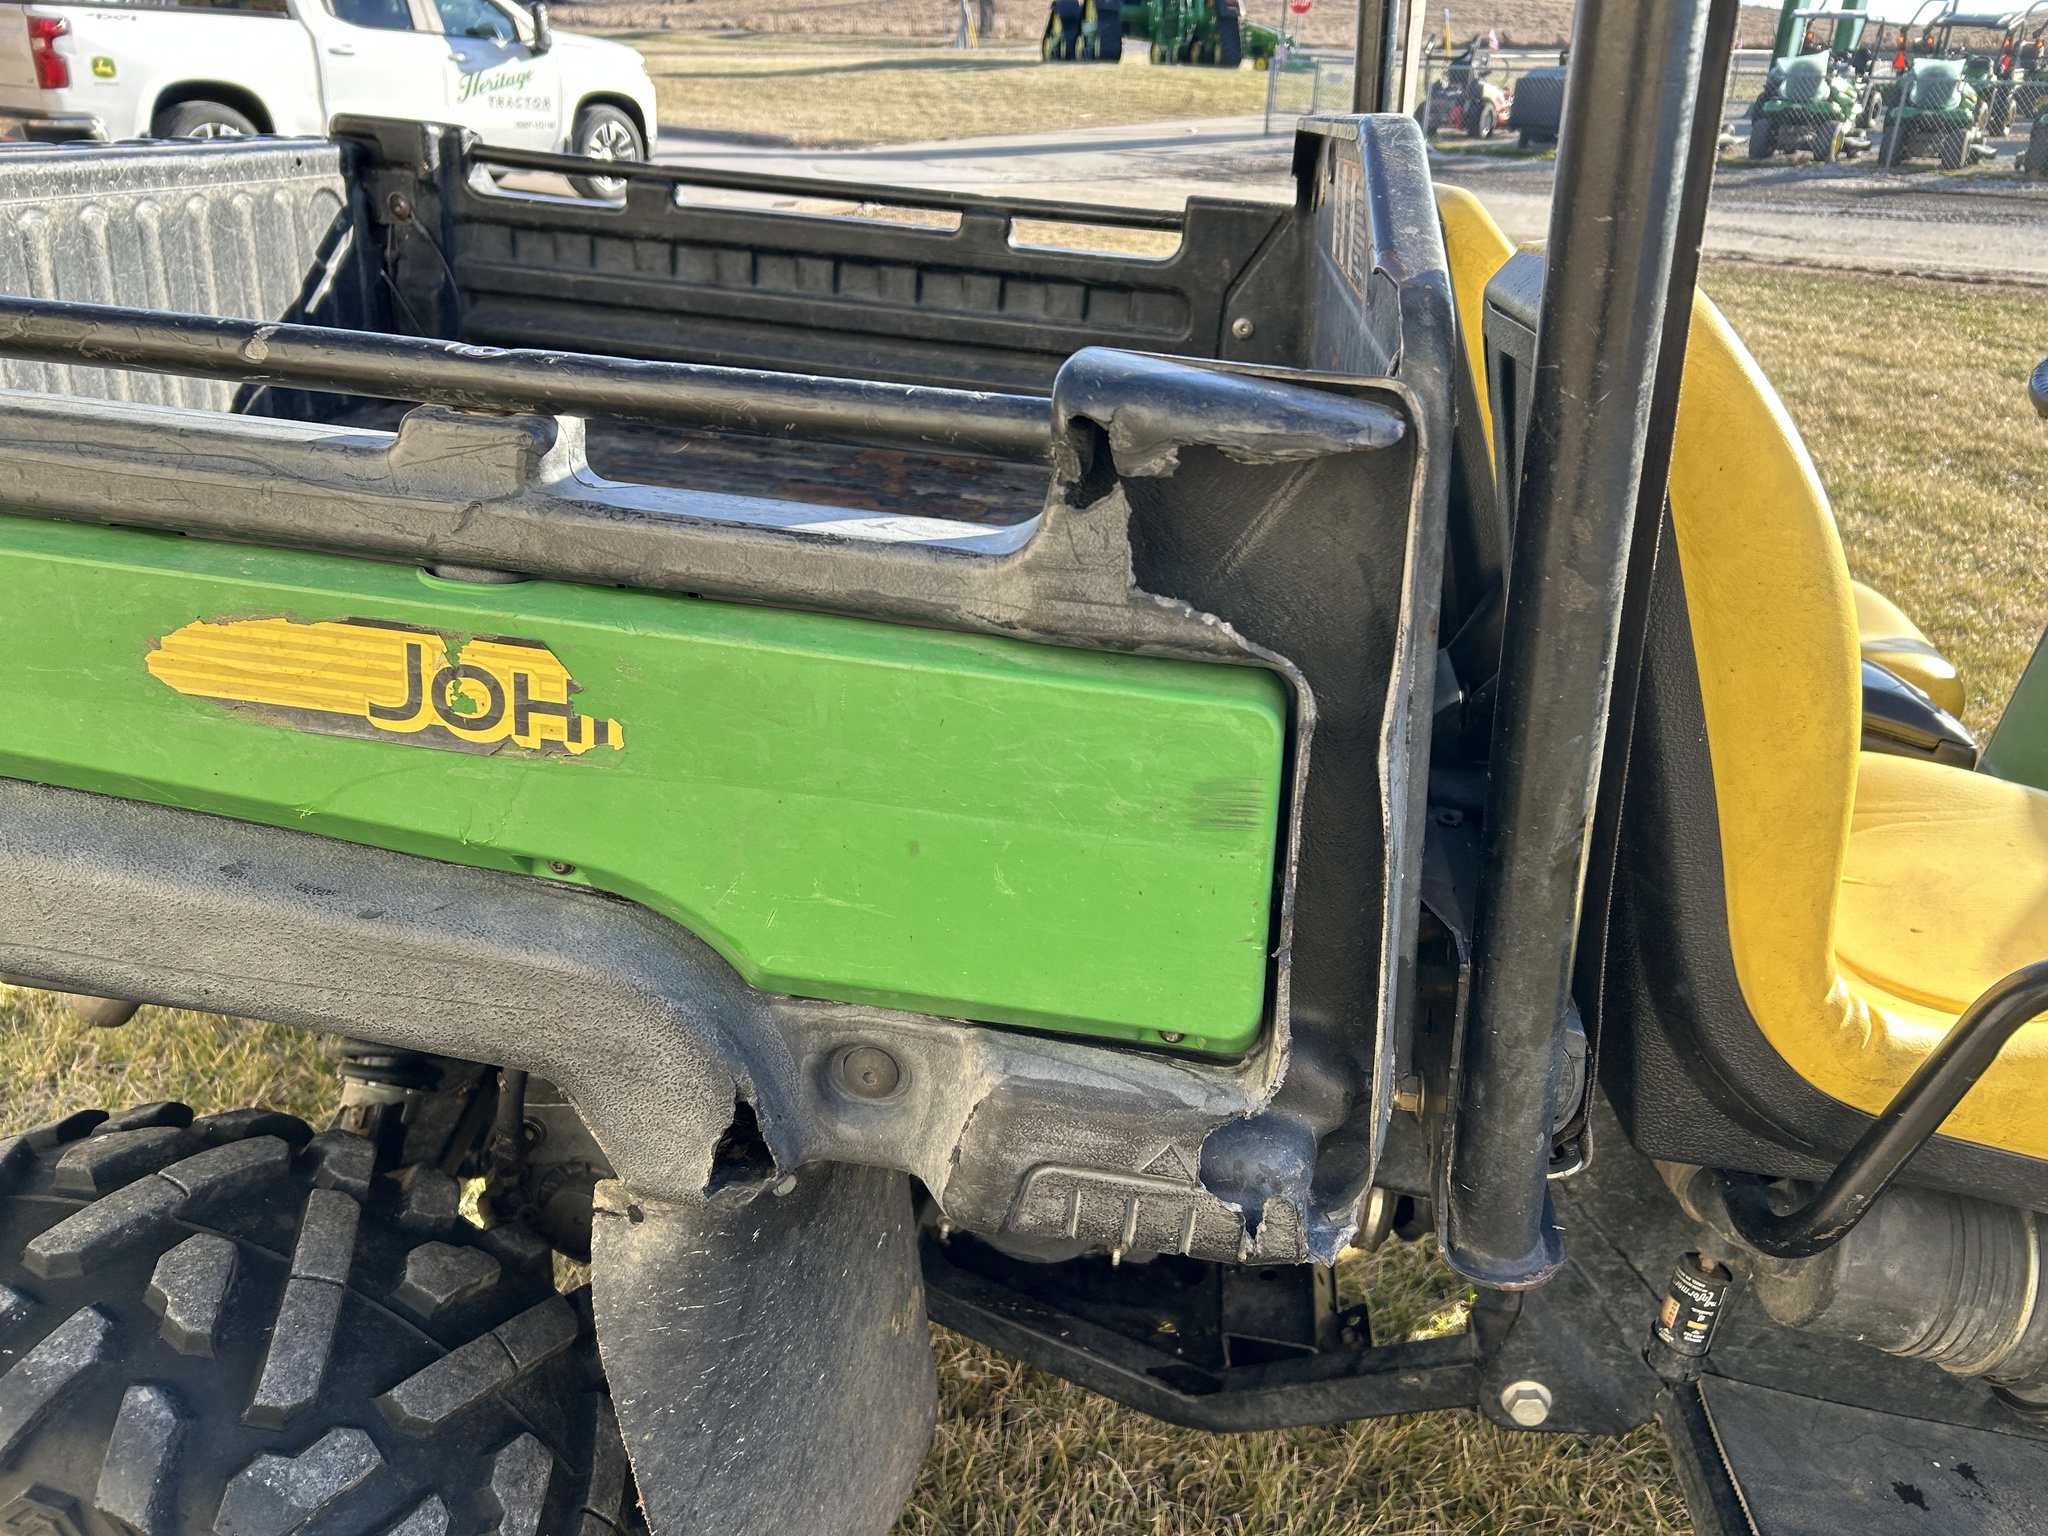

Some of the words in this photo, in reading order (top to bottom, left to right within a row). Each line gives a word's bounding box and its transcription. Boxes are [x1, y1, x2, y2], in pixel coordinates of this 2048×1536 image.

[457, 69, 535, 104] Heritage
[488, 95, 551, 111] TRACTOR
[368, 642, 610, 746] JOH
[1674, 1280, 1714, 1307] Informer
